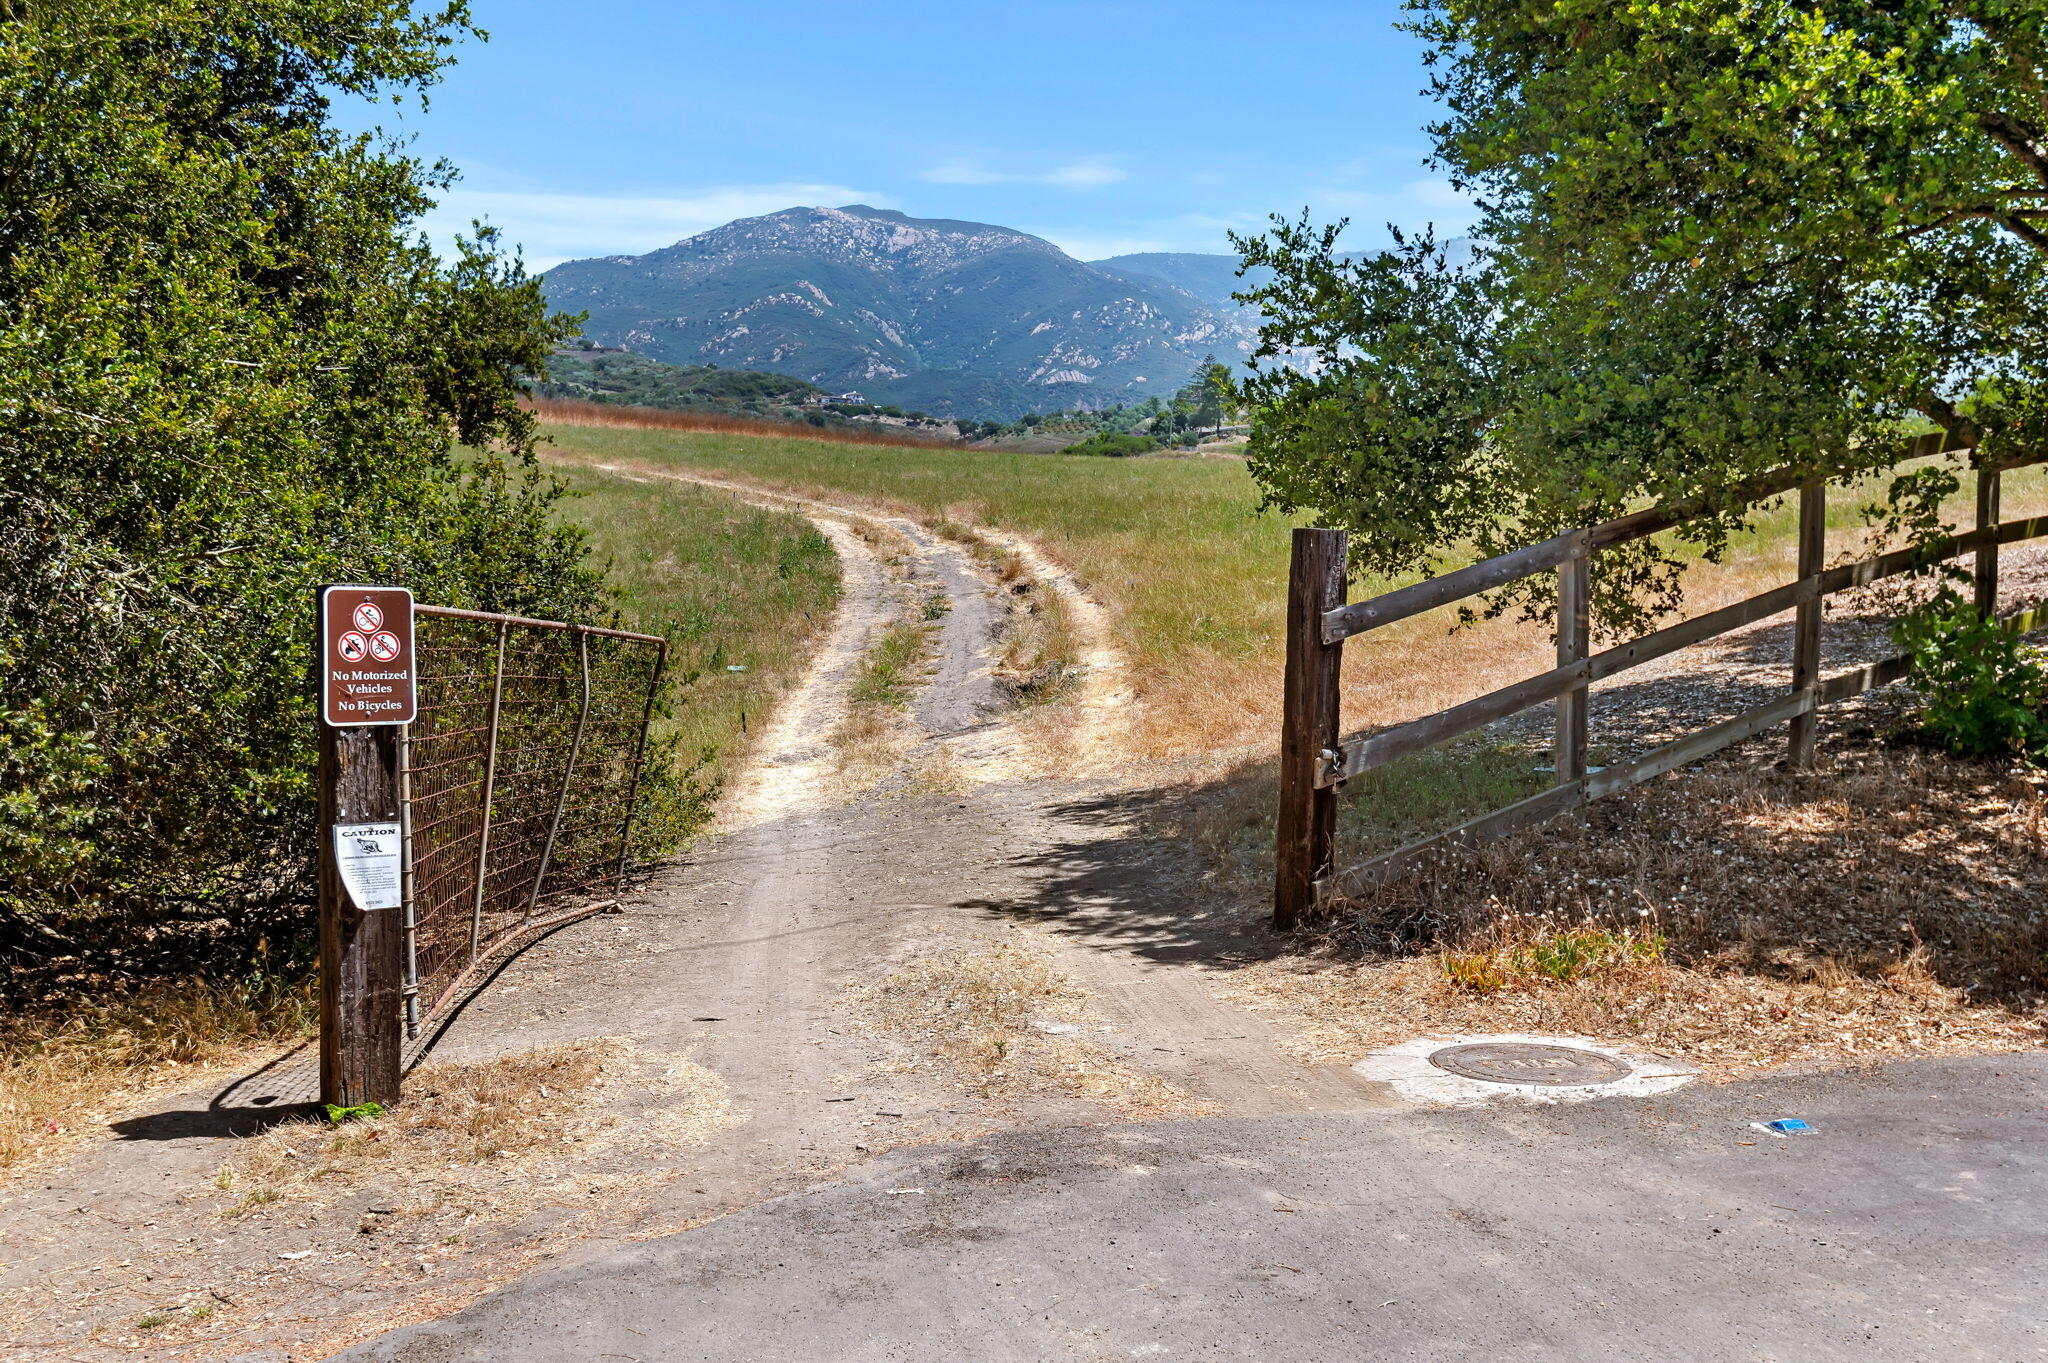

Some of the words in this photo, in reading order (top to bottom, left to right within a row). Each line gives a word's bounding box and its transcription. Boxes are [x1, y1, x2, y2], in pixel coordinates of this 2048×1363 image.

[332, 670, 350, 681] No
[352, 669, 408, 680] Motorized
[347, 683, 393, 694] Vehicles
[338, 700, 356, 711] No
[357, 699, 403, 713] Bicycles
[341, 828, 396, 838] CAUTION
